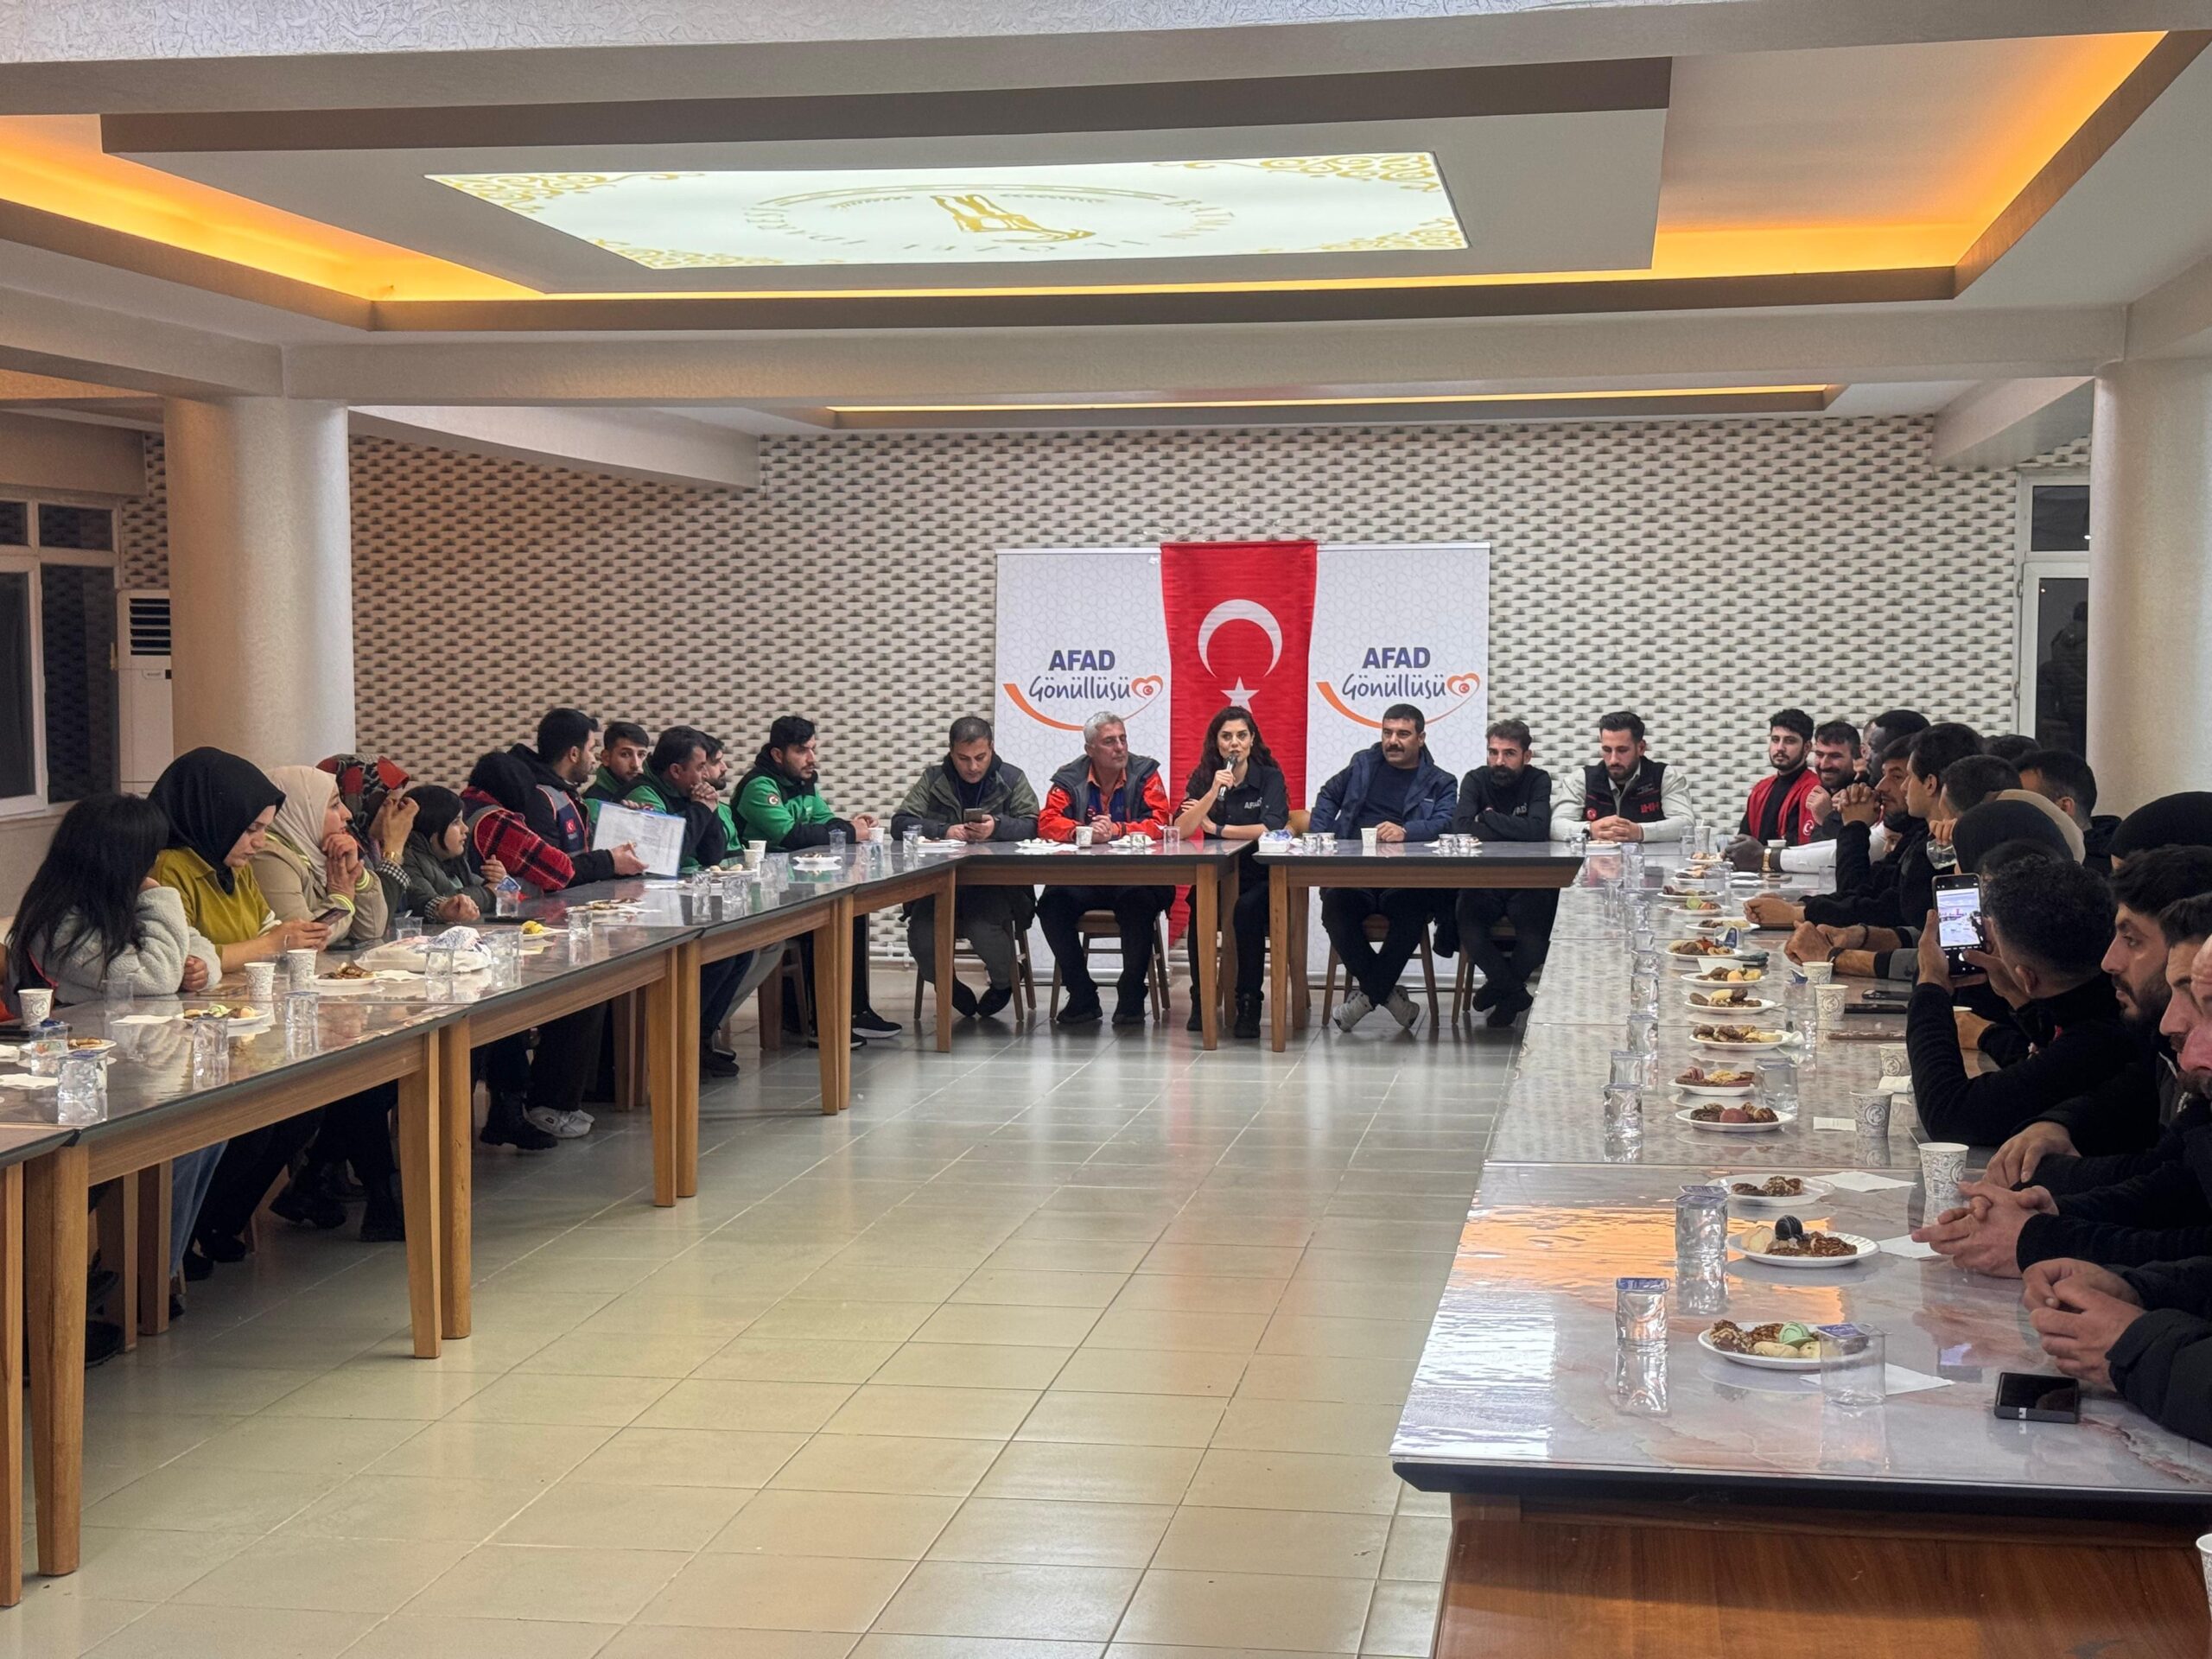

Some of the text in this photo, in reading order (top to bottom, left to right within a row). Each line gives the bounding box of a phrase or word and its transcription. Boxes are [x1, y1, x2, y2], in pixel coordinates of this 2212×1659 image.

[1048, 650, 1116, 671] AFAD
[1362, 647, 1431, 669] AFAD
[1028, 675, 1131, 702] Gönüllüsü
[1341, 672, 1446, 701] Gönüllüsü
